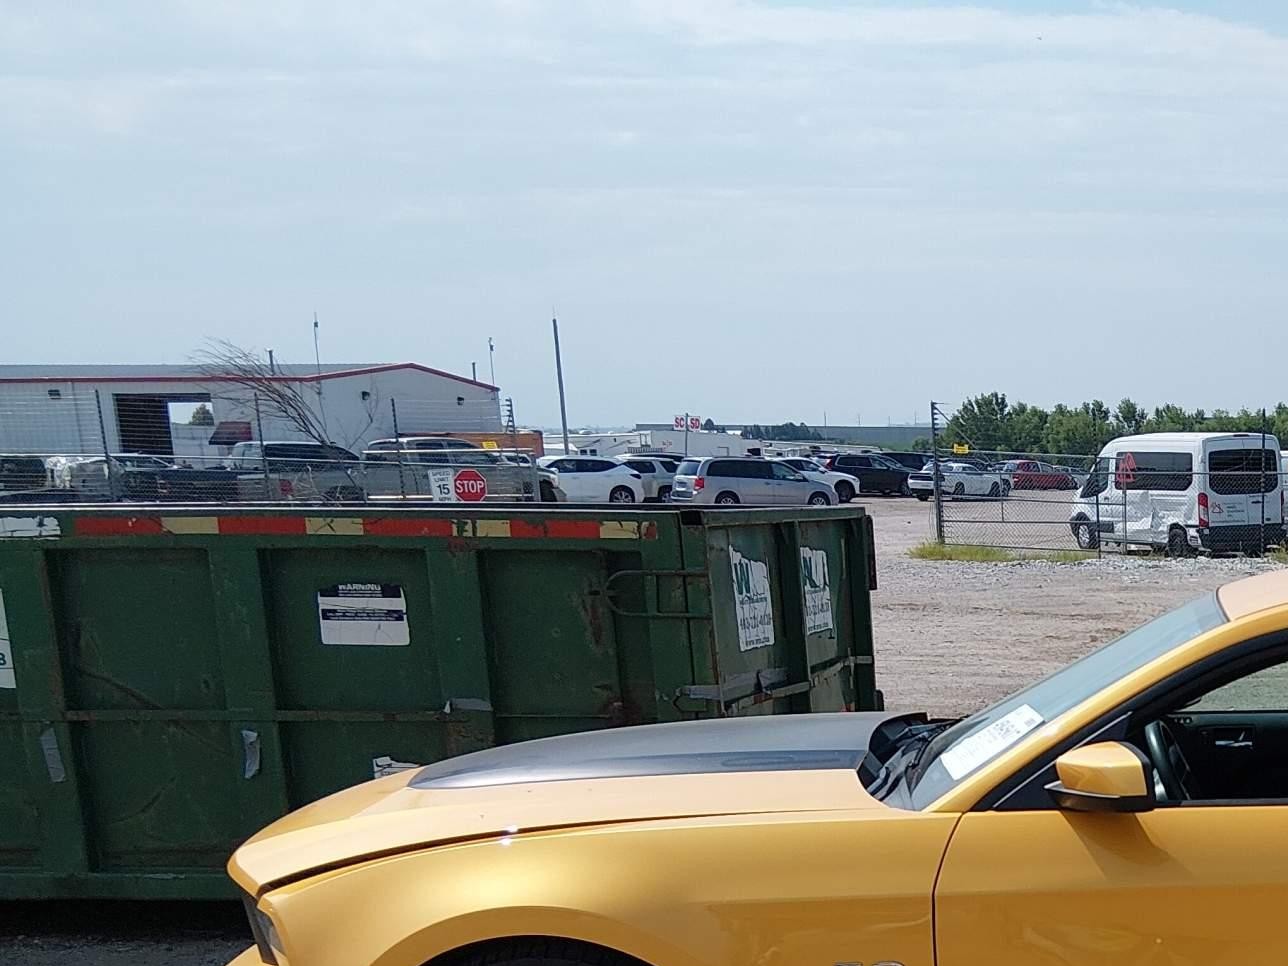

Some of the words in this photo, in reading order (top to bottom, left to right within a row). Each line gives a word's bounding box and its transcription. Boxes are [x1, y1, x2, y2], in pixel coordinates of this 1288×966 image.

[674, 416, 685, 428] SC
[690, 417, 700, 429] SD
[436, 484, 449, 495] 15
[455, 480, 483, 493] STOP
[338, 583, 381, 591] WARNING
